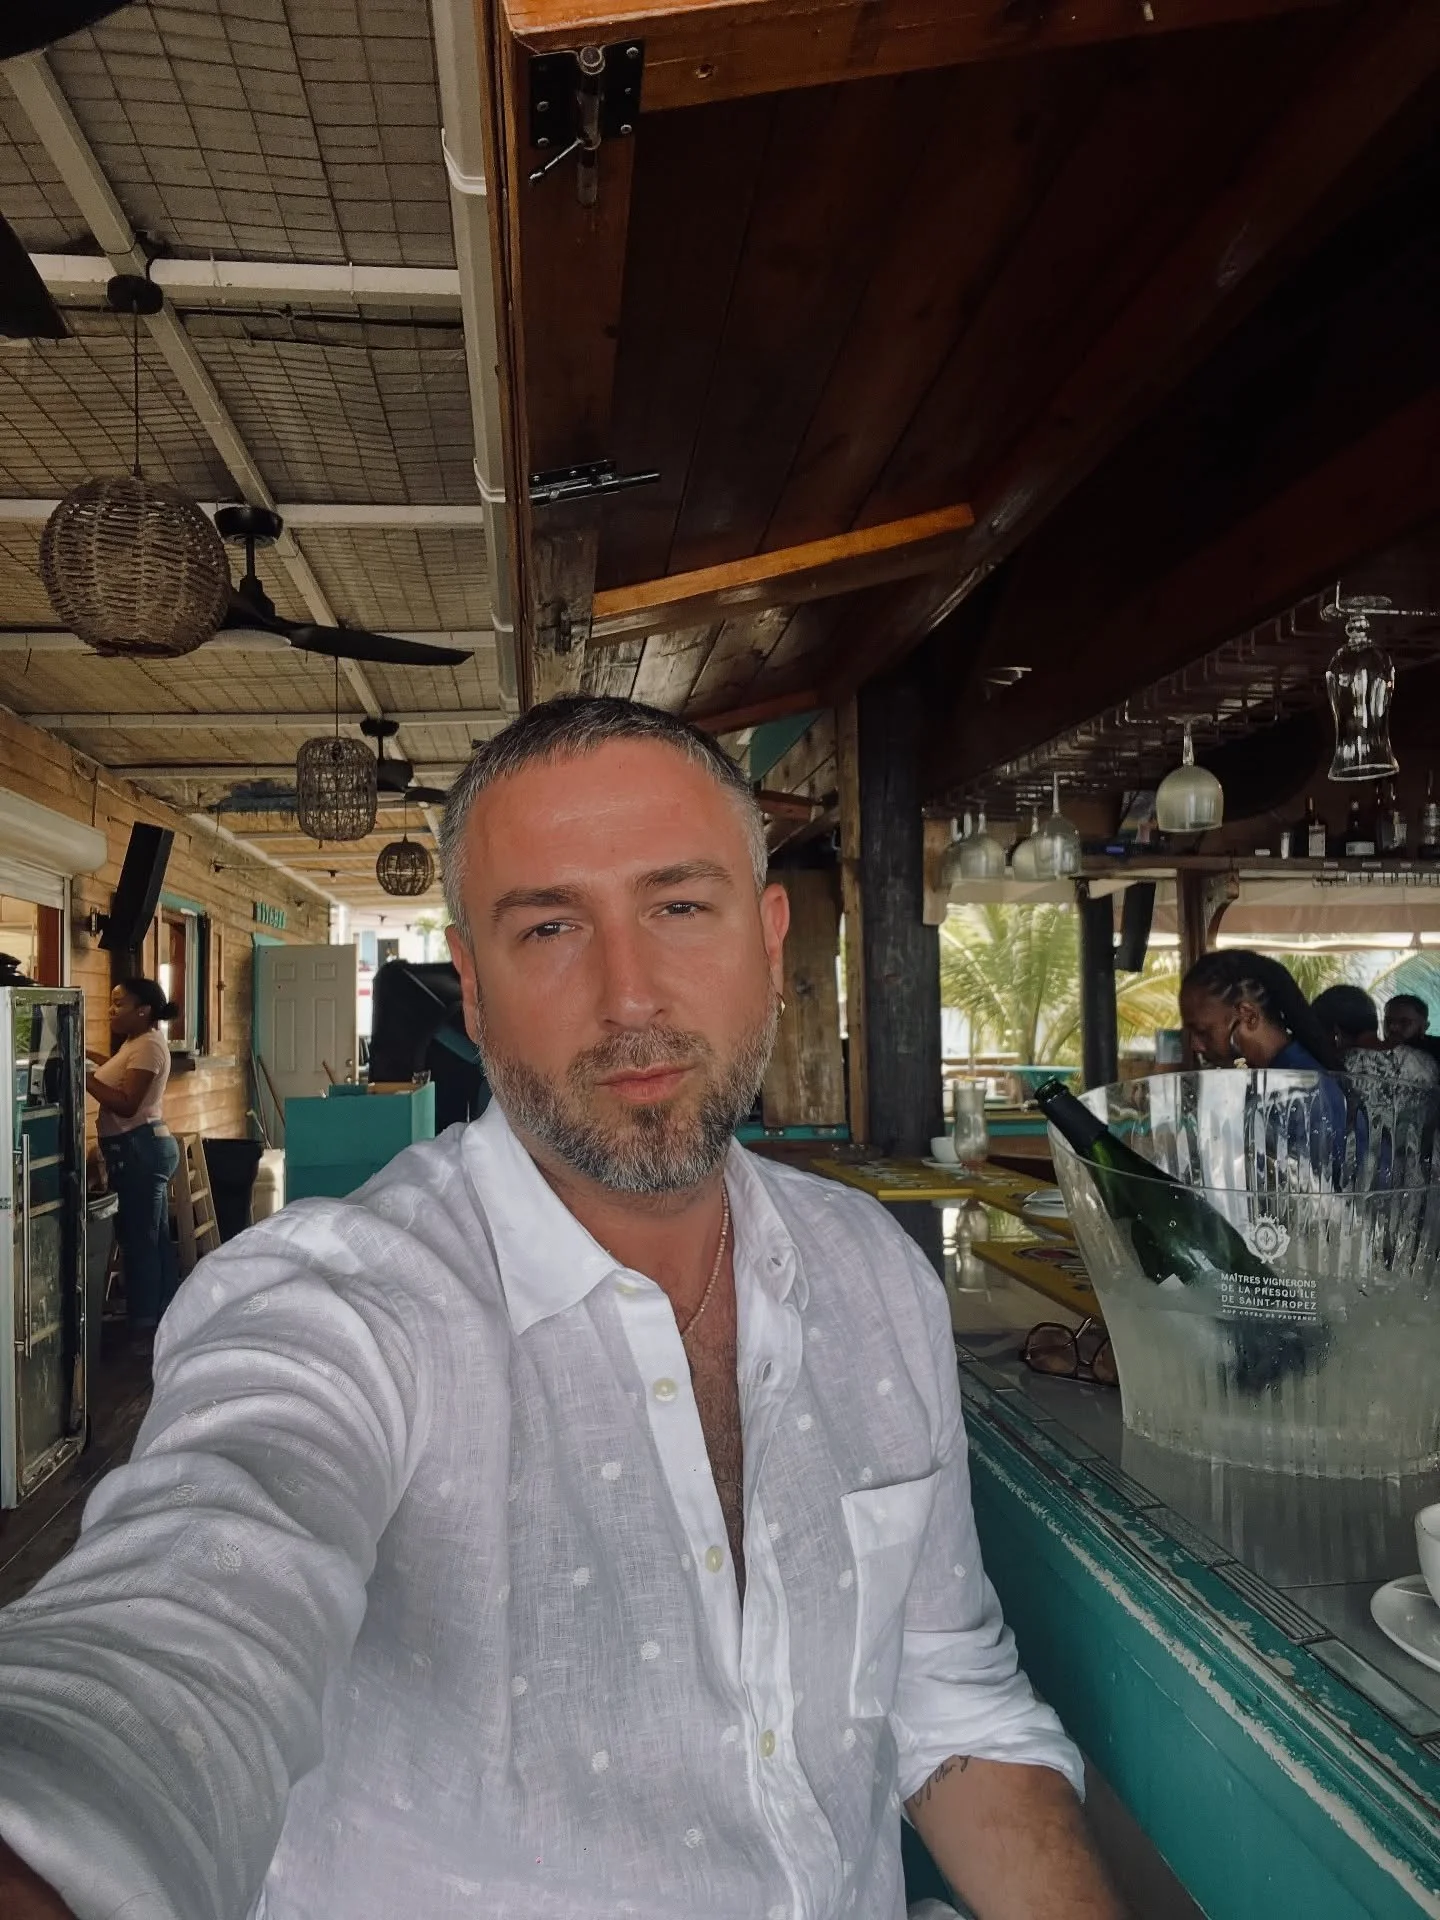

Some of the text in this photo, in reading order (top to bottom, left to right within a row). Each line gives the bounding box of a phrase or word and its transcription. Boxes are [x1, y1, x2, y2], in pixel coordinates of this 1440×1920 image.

[1221, 1272, 1316, 1288] MAÎTRES VIGNERONS
[1221, 1284, 1235, 1292] DE
[1238, 1285, 1250, 1294] LA
[1221, 1294, 1316, 1310] DE SAINT-TROPEZ
